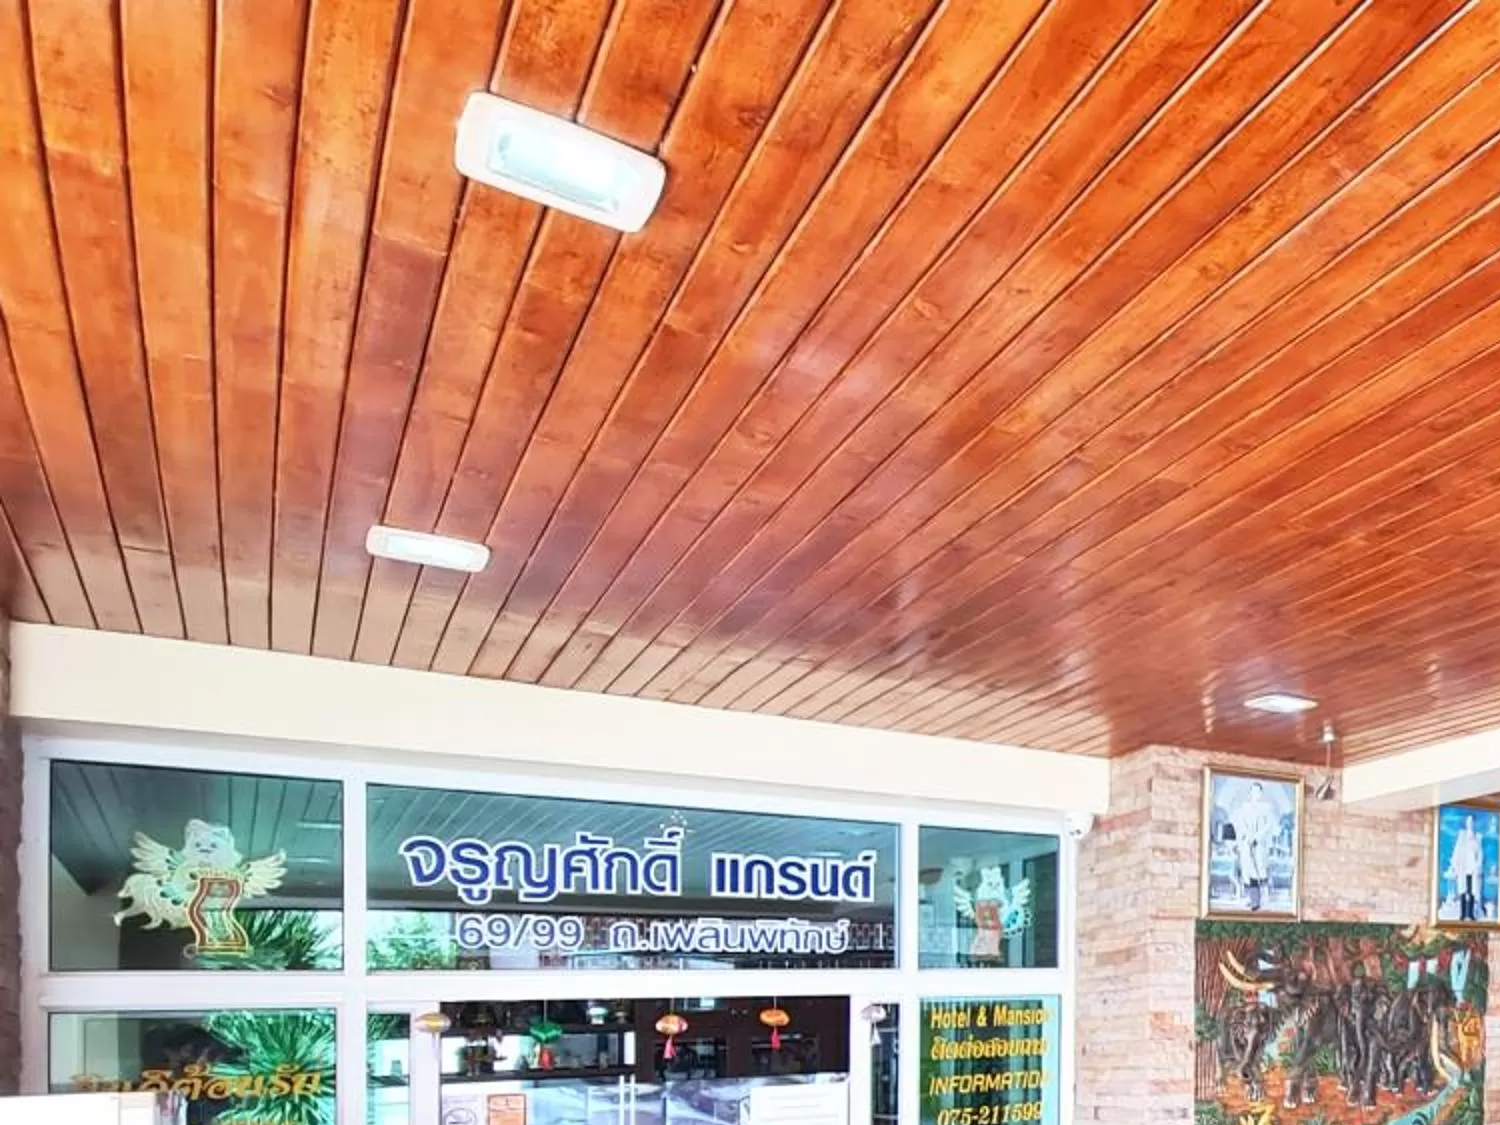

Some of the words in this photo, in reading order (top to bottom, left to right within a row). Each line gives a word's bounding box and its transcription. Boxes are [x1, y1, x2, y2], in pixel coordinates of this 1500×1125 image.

[399, 828, 684, 902] จรูญศักดิ์
[711, 849, 877, 900] แกรนด์
[456, 916, 583, 950] 69/99
[929, 1005, 971, 1029] Hotel
[975, 1005, 988, 1028] &
[993, 1003, 1053, 1027] Mansio
